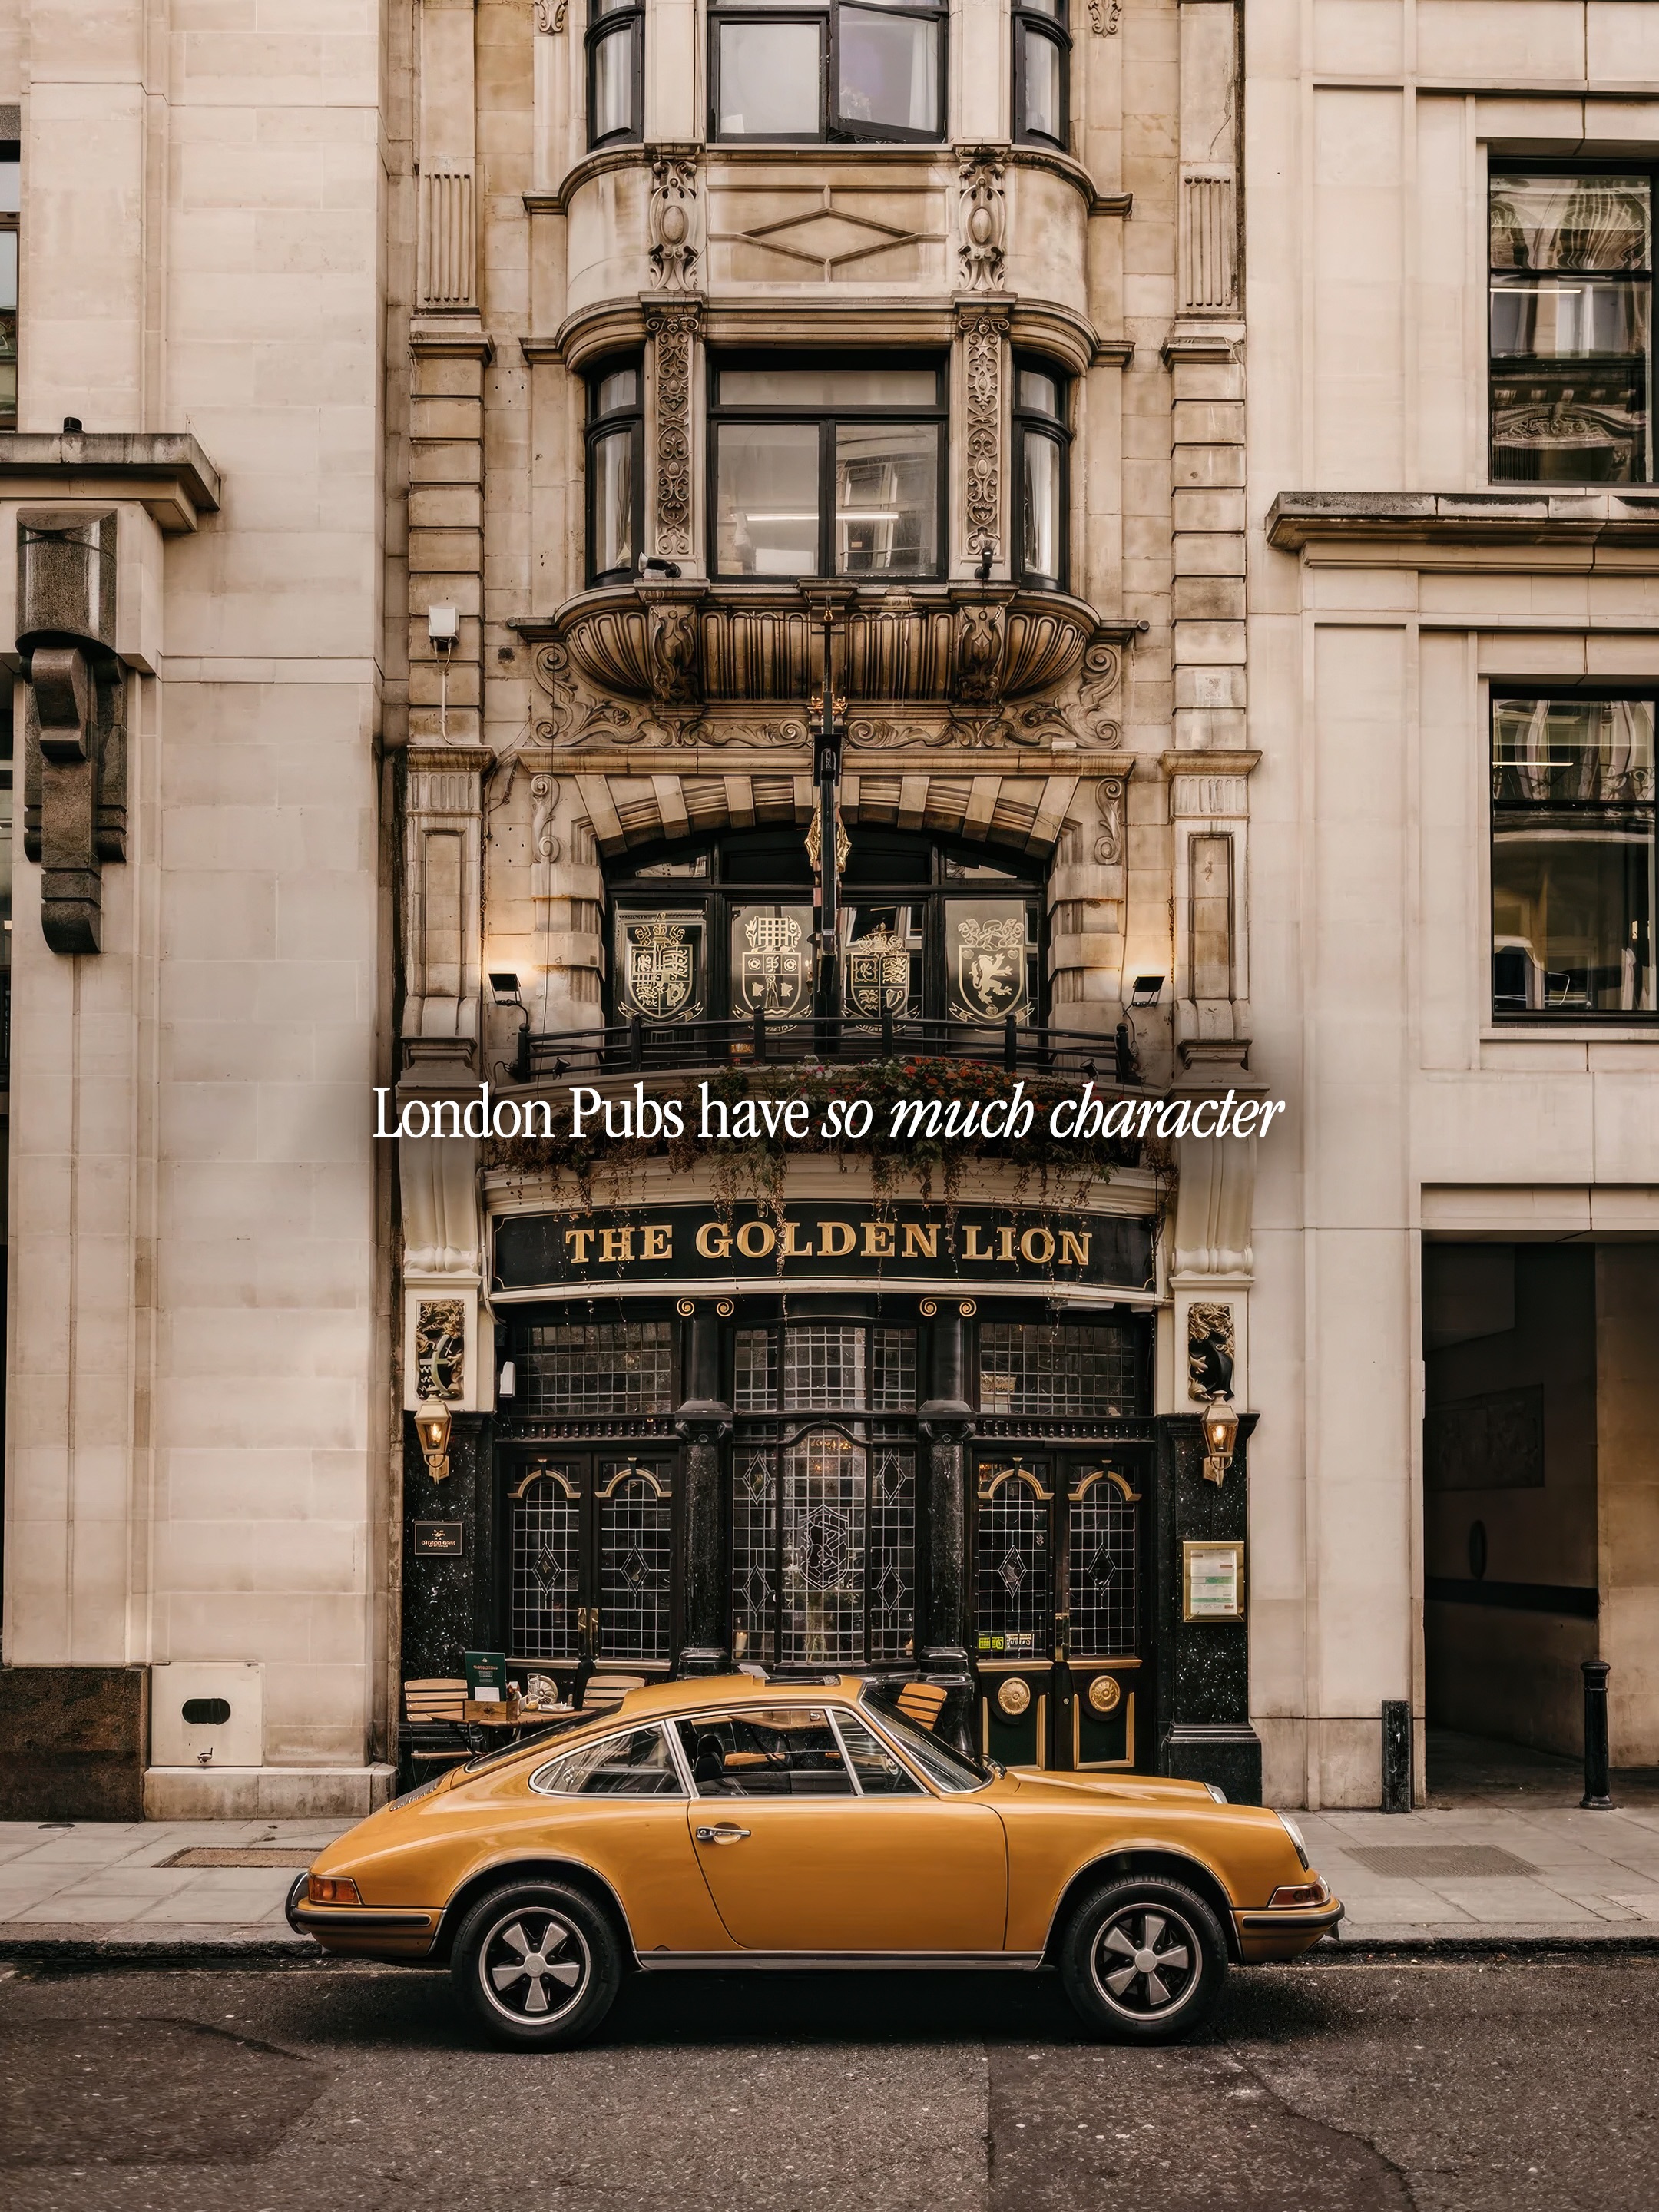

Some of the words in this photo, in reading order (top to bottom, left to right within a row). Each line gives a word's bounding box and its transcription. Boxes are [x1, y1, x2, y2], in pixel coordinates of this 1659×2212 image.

[565, 1224, 673, 1263] THE
[696, 1221, 940, 1259] GOLDEN
[962, 1225, 1092, 1266] LION
